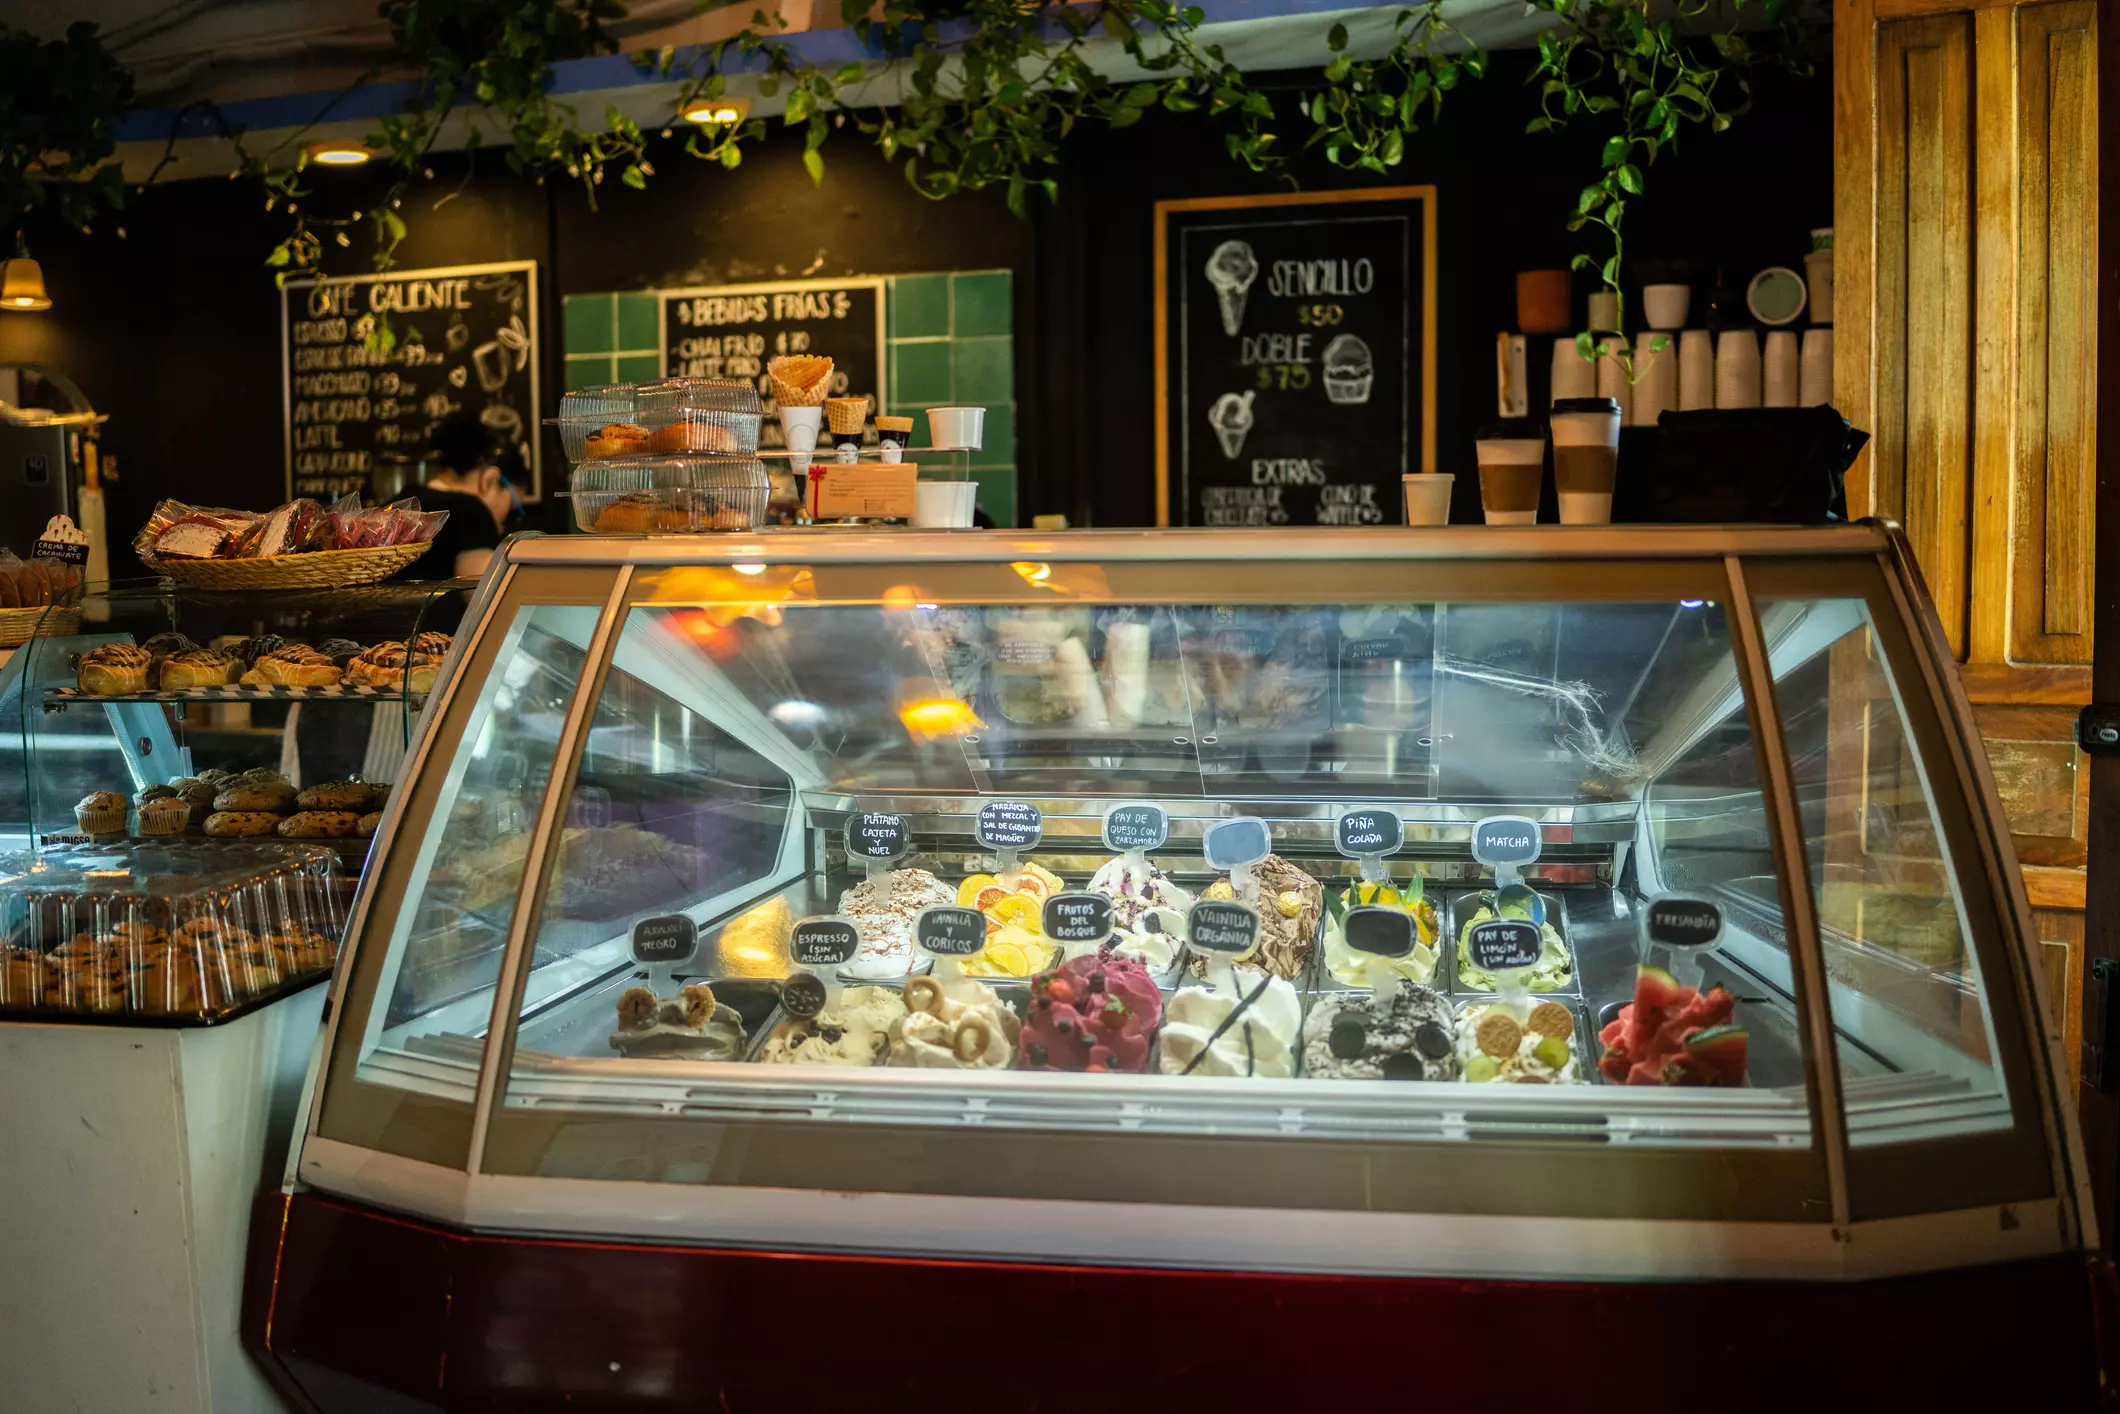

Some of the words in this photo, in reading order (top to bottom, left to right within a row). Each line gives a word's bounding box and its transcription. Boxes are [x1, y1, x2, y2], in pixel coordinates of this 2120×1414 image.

[1268, 257, 1374, 297] SENCILLO
[369, 280, 472, 313] CALIENTE
[1240, 333, 1313, 365] DOBLE
[1252, 458, 1326, 485] EXTRAS
[38, 542, 65, 551] CREMA
[992, 803, 1029, 811] NARANJA
[1001, 812, 1028, 820] MEZCAL
[1031, 813, 1037, 821] Y
[1115, 812, 1131, 823] PAY
[1135, 814, 1148, 824] DE
[983, 821, 996, 829] SAL
[998, 822, 1007, 830] DE
[1346, 817, 1375, 830] PIÑA
[862, 828, 897, 838] CAJETA
[985, 832, 994, 840] DE
[1110, 825, 1137, 836] QUESO
[1140, 827, 1156, 837] CON
[873, 839, 881, 847] Y
[1115, 836, 1158, 845] ZARZAMORA
[1347, 833, 1383, 844] COLADA
[1486, 836, 1529, 848] MATCHA
[868, 846, 890, 855] NUEZ
[1057, 903, 1095, 916] FRUTOS
[1070, 916, 1089, 926] DEL
[1197, 909, 1251, 929] VAINILLA
[946, 926, 953, 938] Y
[1057, 926, 1097, 938] BOSQUE
[1477, 930, 1497, 942] PAY
[1501, 930, 1518, 941] DE
[641, 937, 677, 951] NEGRO
[798, 933, 850, 944] ESPRESSO
[809, 944, 832, 954] (SIN
[926, 936, 972, 954] CORICOS
